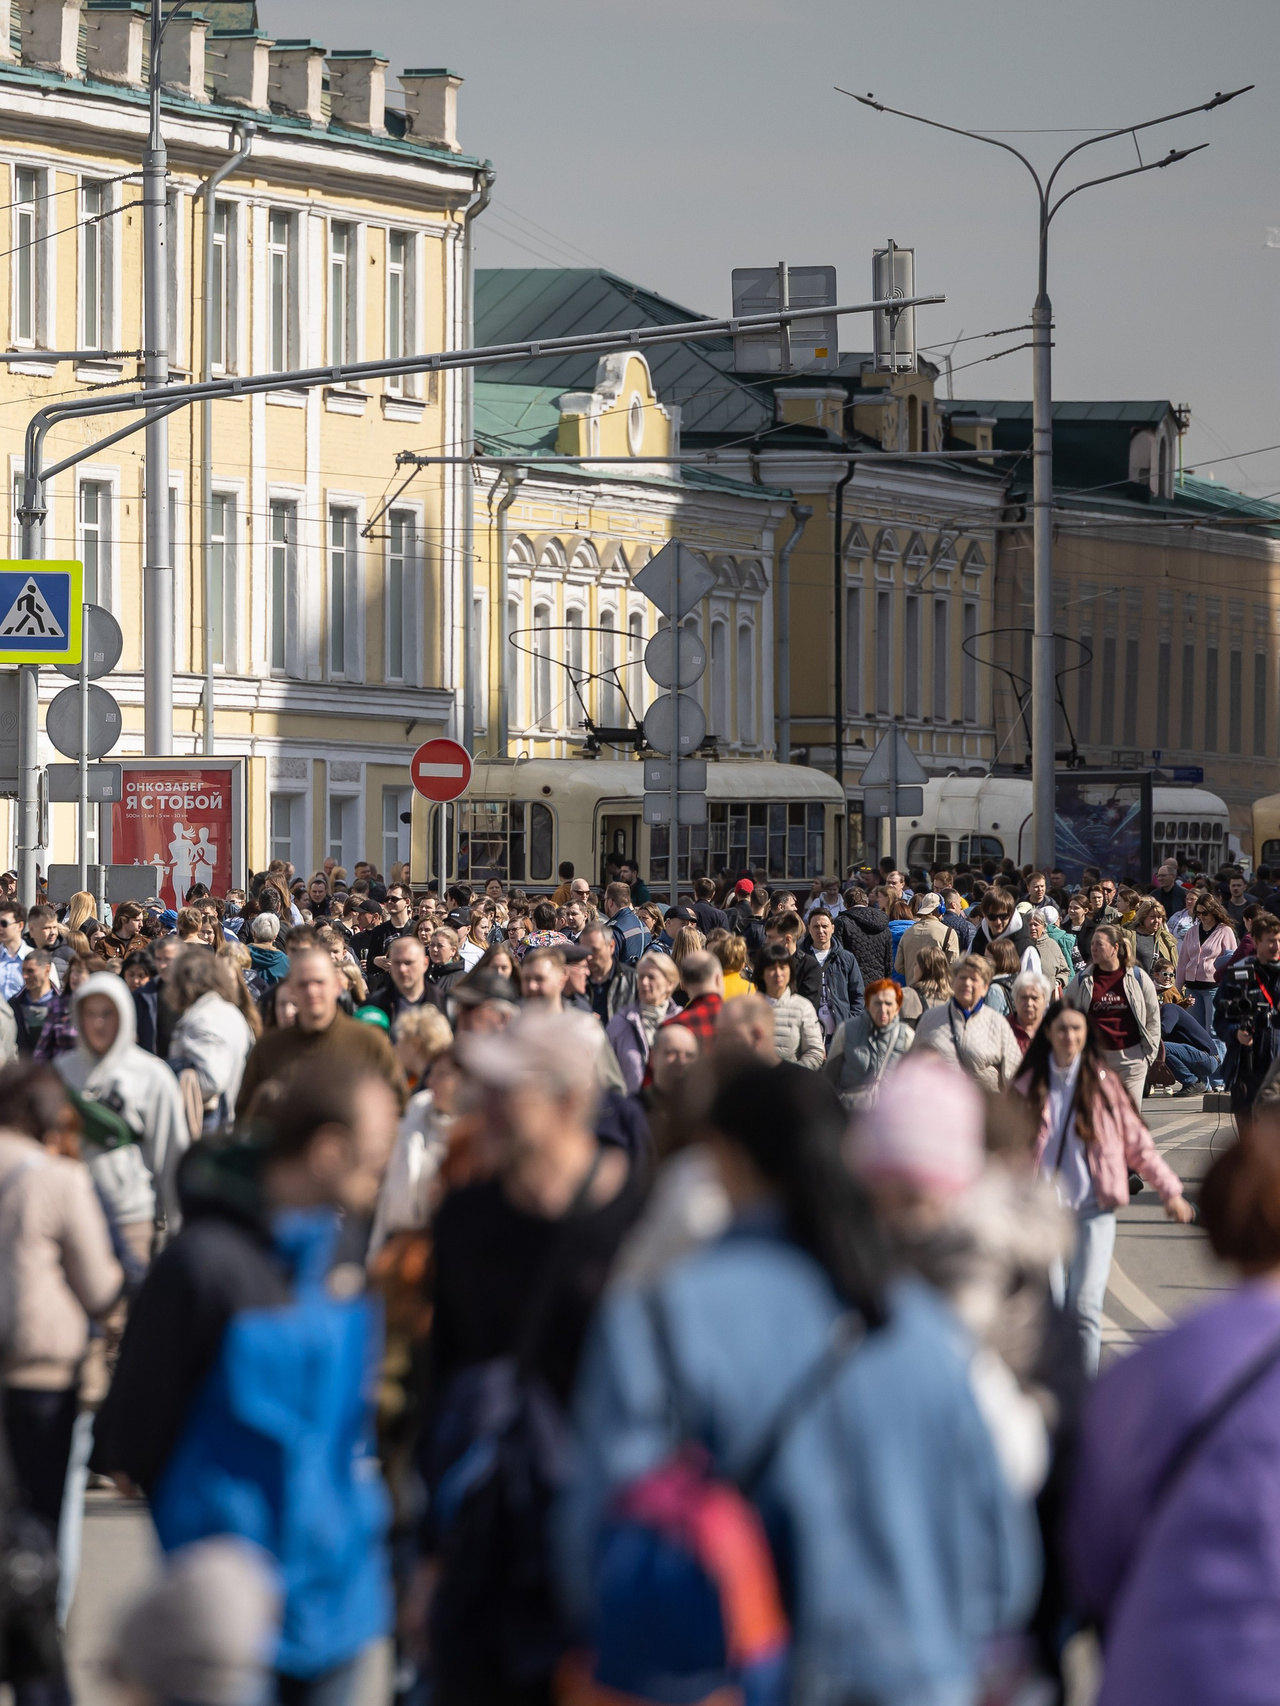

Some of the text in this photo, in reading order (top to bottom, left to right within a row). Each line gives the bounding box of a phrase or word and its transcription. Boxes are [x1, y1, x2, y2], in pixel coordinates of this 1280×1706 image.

[126, 782, 204, 792] ОНКОЗАБЕГ
[126, 791, 223, 810] Я С ТОБОЙ
